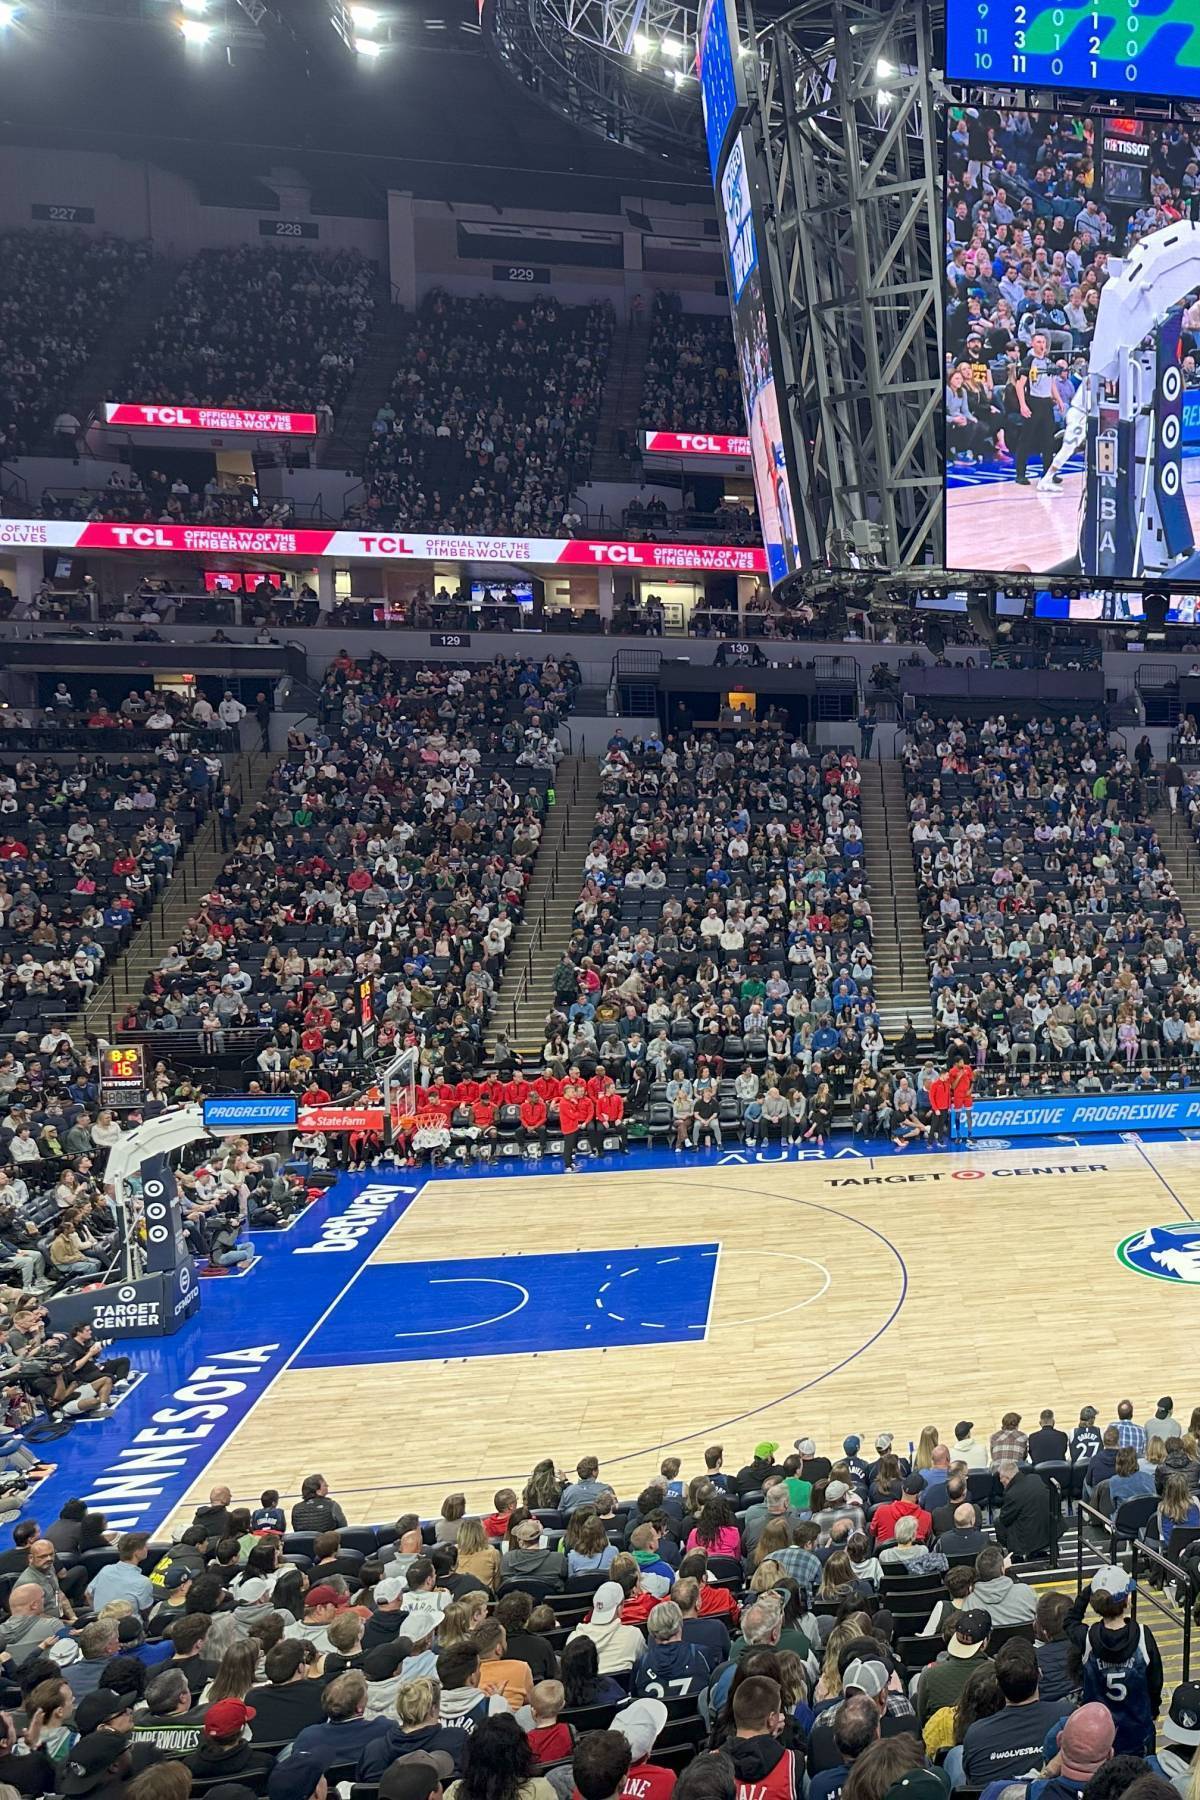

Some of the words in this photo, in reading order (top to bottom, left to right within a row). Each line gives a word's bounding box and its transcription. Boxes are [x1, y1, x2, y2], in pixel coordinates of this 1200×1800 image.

[977, 4, 988, 19] 9
[1014, 6, 1026, 24] 2
[1053, 9, 1064, 26] 0
[1092, 12, 1098, 29] 1
[1127, 15, 1139, 32] 0
[976, 28, 988, 44] 11
[1014, 31, 1026, 49] 3
[1054, 34, 1060, 51] 1
[1089, 37, 1100, 54] 2
[1126, 40, 1138, 57] 0
[974, 53, 992, 69] 10
[1012, 55, 1026, 73] 11
[1052, 58, 1063, 76] 0
[1090, 61, 1097, 78] 1
[1125, 64, 1137, 81] 0
[1119, 144, 1150, 157] TISSOT
[49, 208, 76, 221] 227
[276, 223, 301, 236] 228
[509, 269, 535, 282] 229
[141, 408, 191, 424] TCL
[199, 411, 241, 420] OFFICIAL
[244, 413, 255, 421] TV
[258, 414, 270, 422] OF
[274, 415, 291, 423] THE
[200, 418, 292, 431] TIMBERWOLVES
[676, 435, 721, 450] TCL
[112, 528, 173, 546] TCL
[184, 530, 236, 541] OFFICIAL
[238, 532, 254, 542] TV
[256, 533, 272, 542] OF
[274, 533, 296, 543] THE
[184, 539, 296, 552] TIMBERWOLVES
[359, 537, 413, 554] TCL
[426, 539, 474, 549] OFFICIAL
[477, 541, 491, 550] TV
[493, 542, 508, 550] OF
[510, 543, 530, 551] THE
[426, 548, 531, 559] TIMBERWOLVES
[589, 545, 644, 563] TCL
[440, 636, 461, 647] 129
[730, 643, 749, 655] 130
[207, 1105, 291, 1119] PROGRESSIVE
[1072, 1103, 1179, 1122] PROGRESSIVE
[824, 1172, 946, 1187] TARGET
[992, 1163, 1108, 1177] CENTER
[292, 1183, 417, 1255] betway
[94, 1302, 160, 1317] TARGET
[93, 1314, 160, 1329] CENTER
[1077, 1433, 1099, 1442] GOBERT
[1075, 1442, 1100, 1461] 27
[1105, 1672, 1128, 1701] 5
